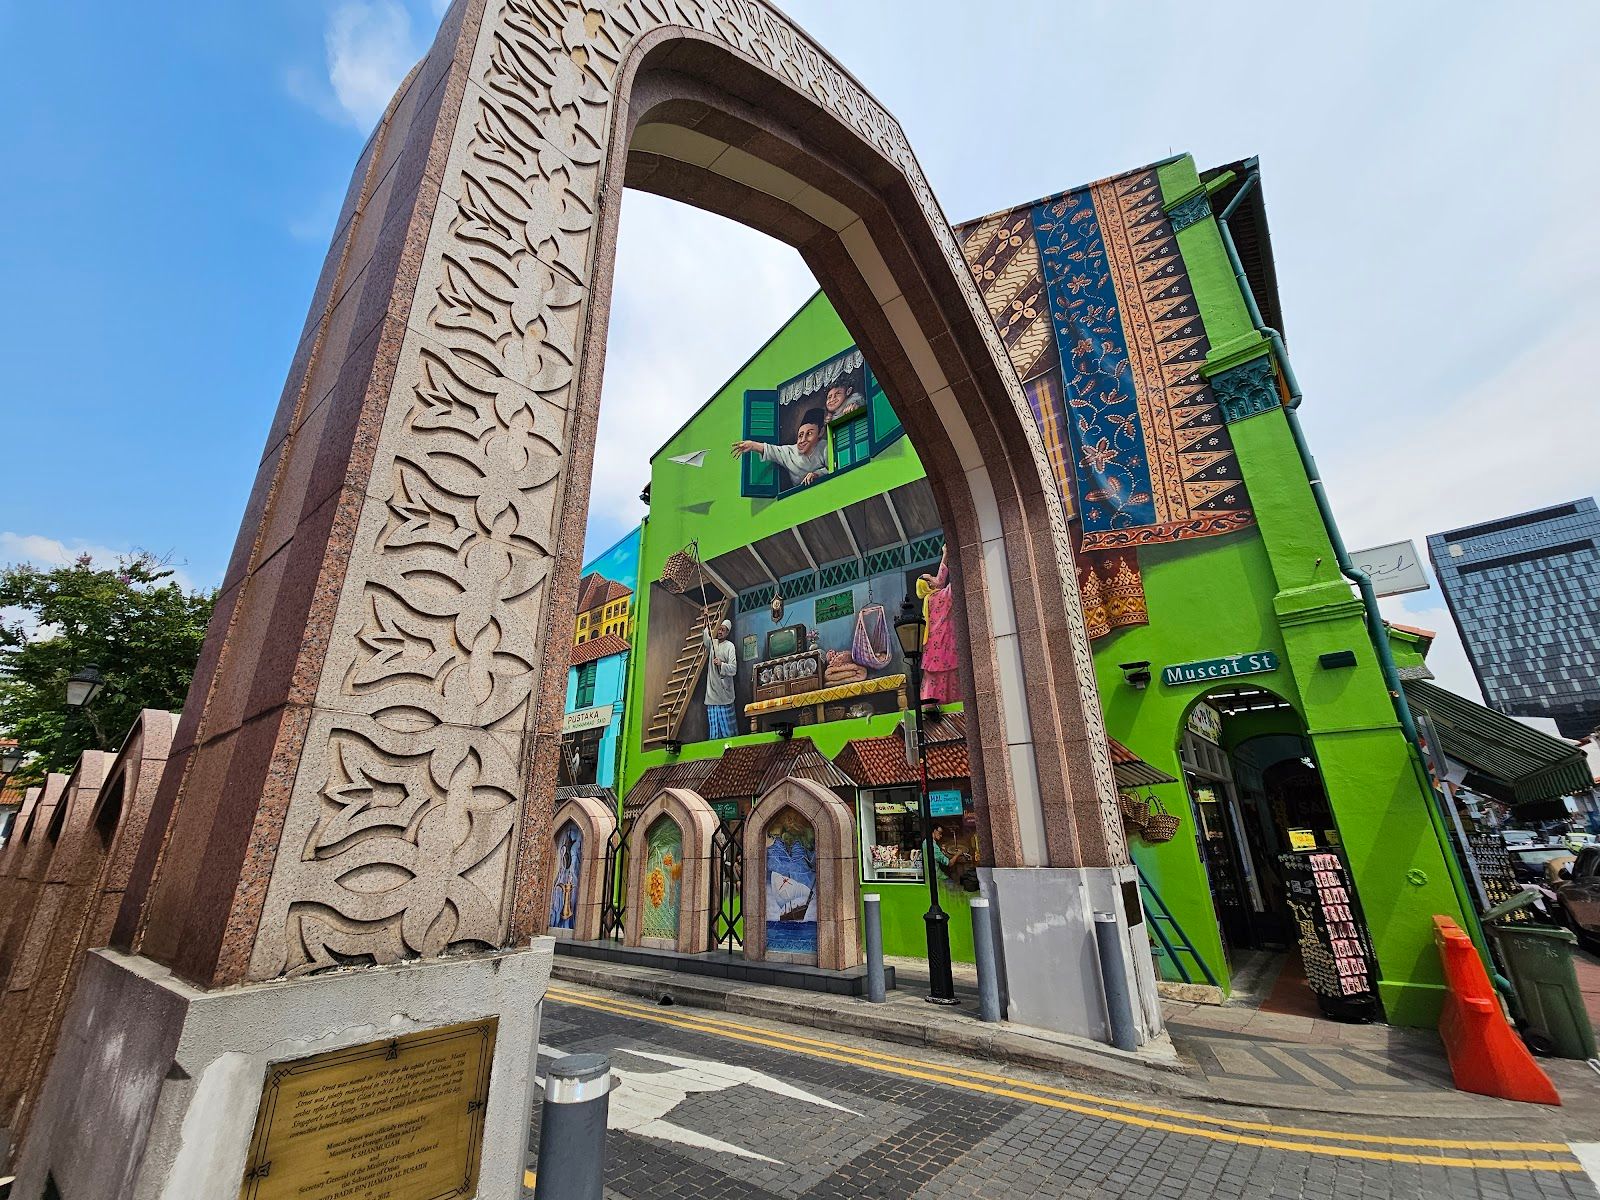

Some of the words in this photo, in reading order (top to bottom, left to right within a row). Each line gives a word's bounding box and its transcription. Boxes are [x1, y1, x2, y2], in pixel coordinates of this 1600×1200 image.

[1470, 542, 1497, 554] PAN
[1503, 529, 1557, 546] PACIFIC
[1167, 659, 1241, 682] Muscat
[1249, 655, 1272, 670] St
[567, 711, 599, 724] PUSTAKA
